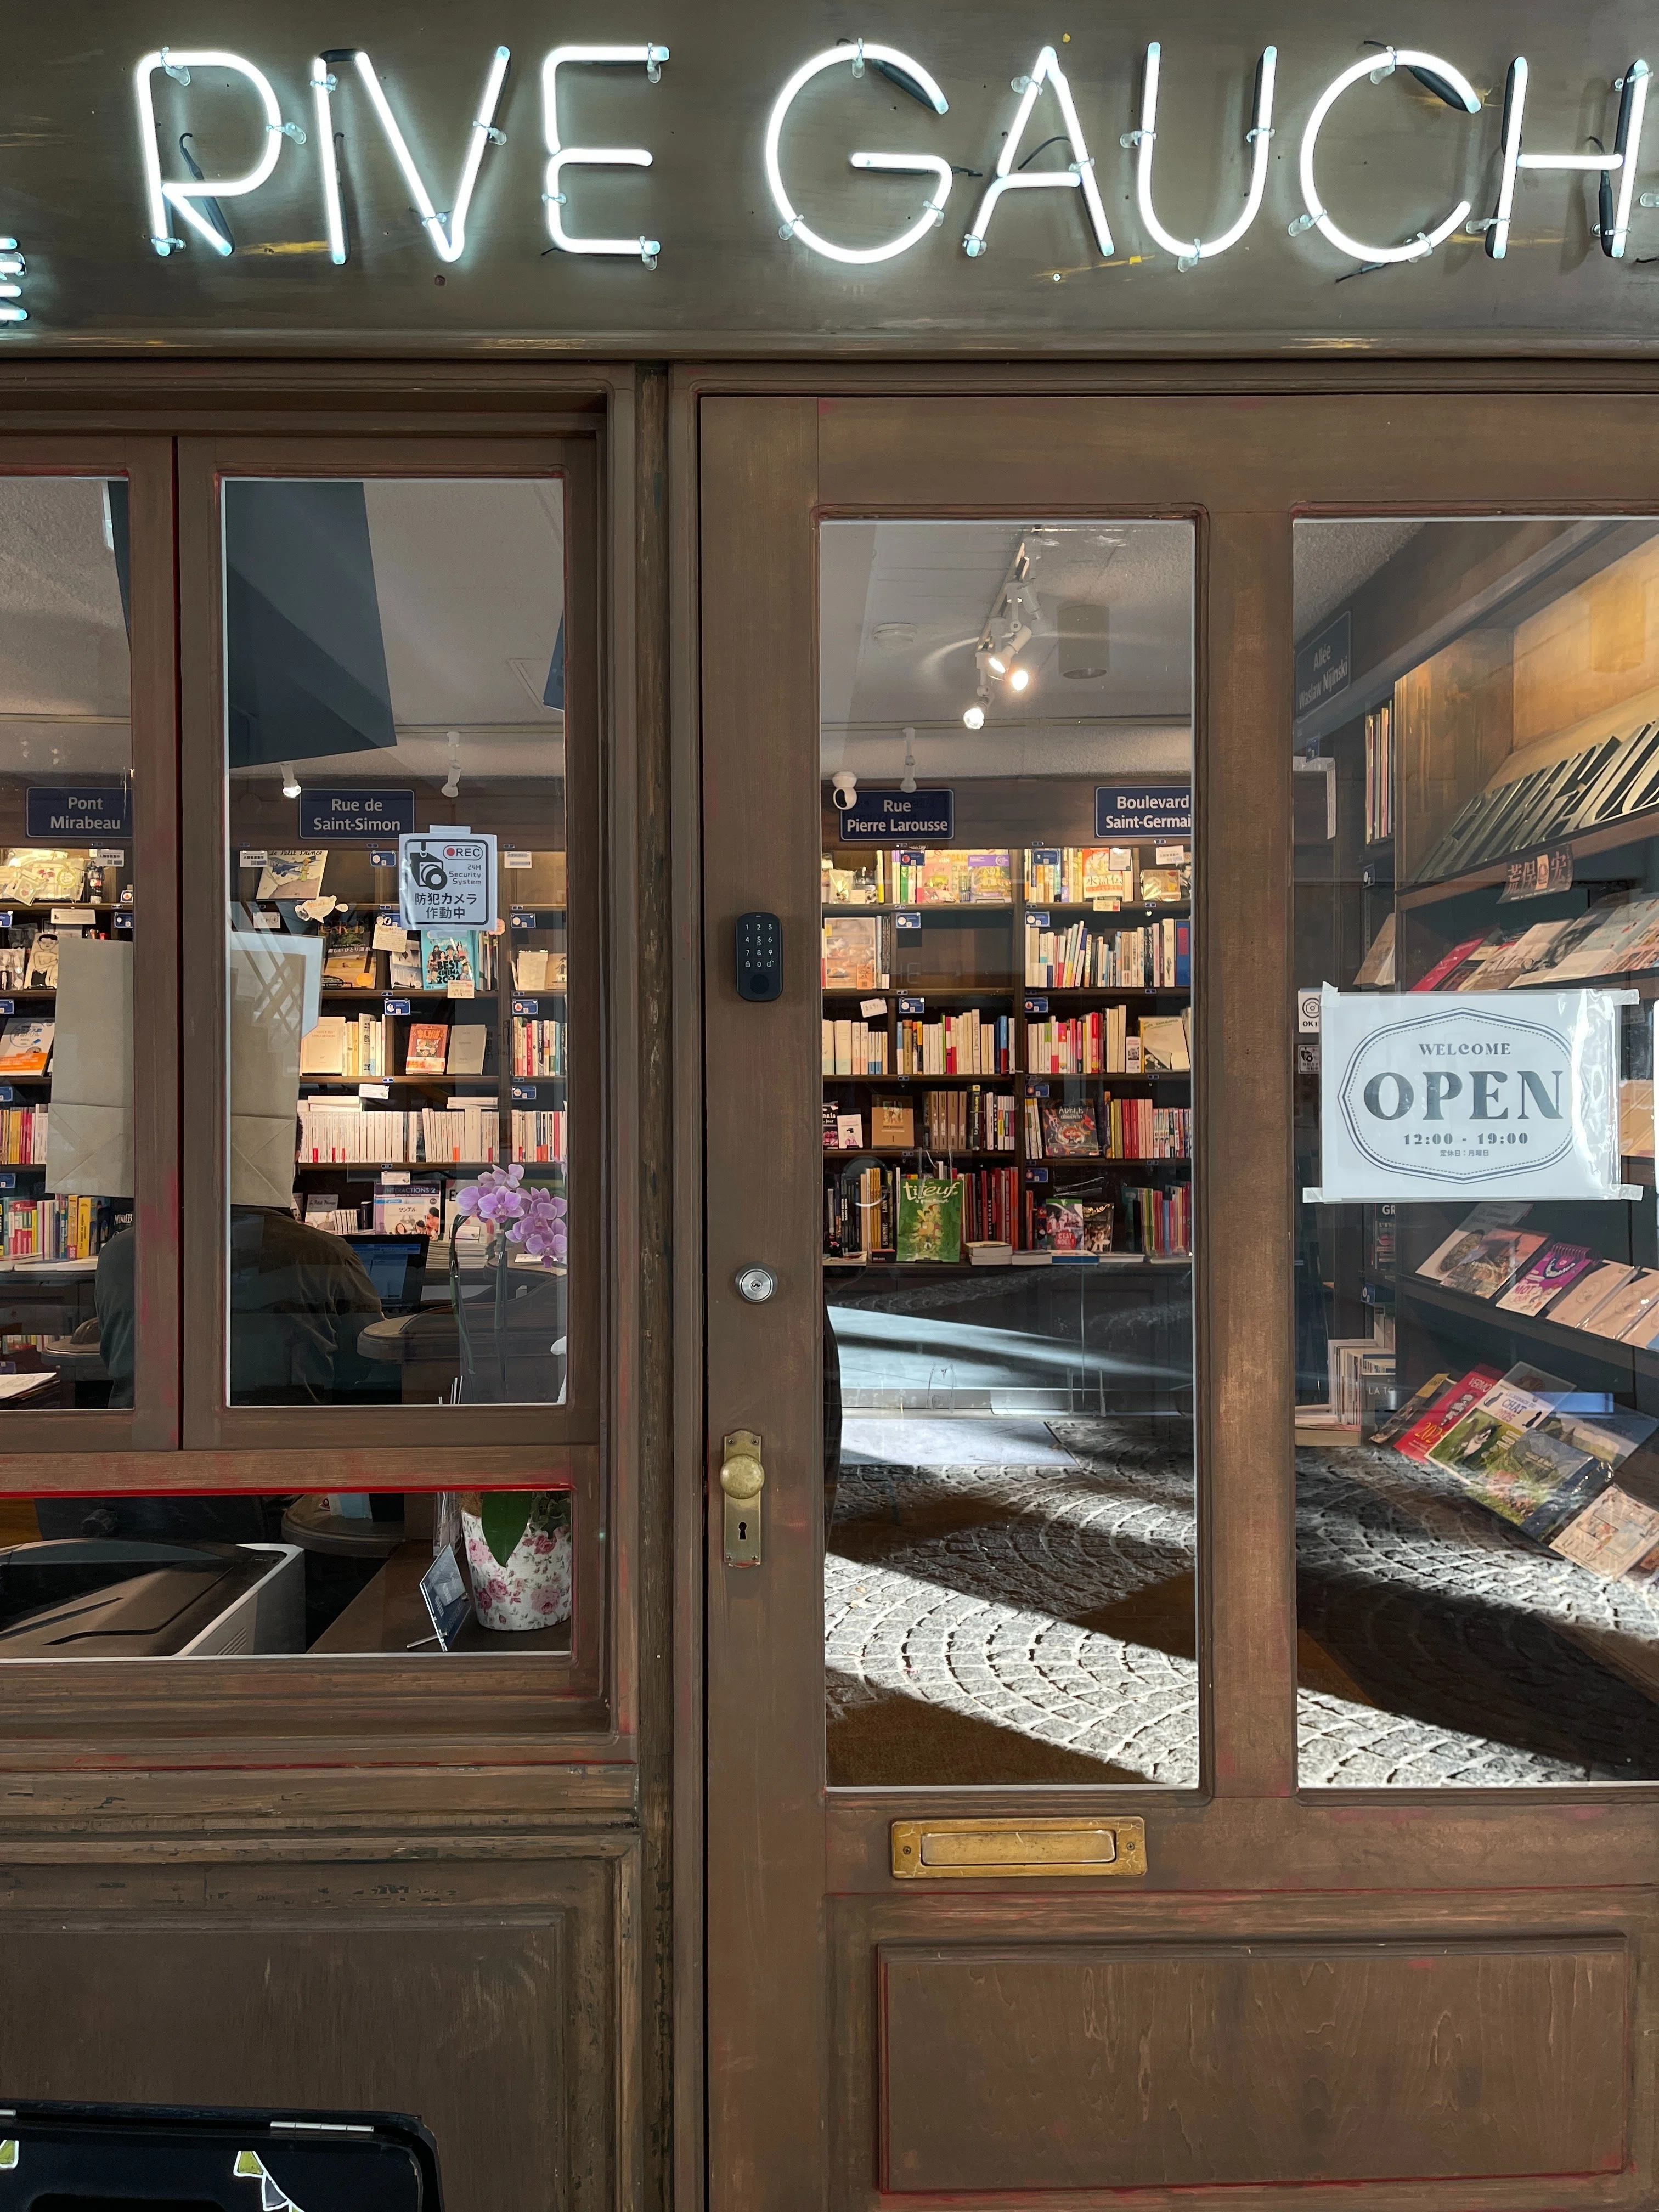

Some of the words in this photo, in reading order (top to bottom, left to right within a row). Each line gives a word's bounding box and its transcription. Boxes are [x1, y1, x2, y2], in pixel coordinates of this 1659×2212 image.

[136, 46, 669, 264] RIVE
[765, 42, 1649, 264] GAUCH
[1313, 644, 1331, 672] Allée
[68, 797, 104, 810] Pont
[331, 798, 360, 811] Rue
[364, 798, 383, 811] de
[883, 799, 911, 812] Rue
[1116, 794, 1189, 809] Boulevard
[50, 815, 121, 830] Mirabeau
[313, 817, 400, 831] Saint-Simon
[847, 819, 887, 832] Pierre
[890, 819, 948, 832] Larousse
[456, 848, 481, 857] REC
[415, 893, 477, 905] 防犯カメラ
[426, 906, 465, 919] 作動中
[437, 960, 460, 970] BEST
[1419, 1043, 1511, 1056] WELCOME
[1363, 1070, 1564, 1121] OPEN
[1403, 1133, 1454, 1146] 12:00
[1477, 1132, 1529, 1145] 19:00
[1440, 1149, 1490, 1157] 定休日：月曜日
[1502, 1398, 1527, 1415] CHAT
[1414, 1421, 1444, 1444] 202
